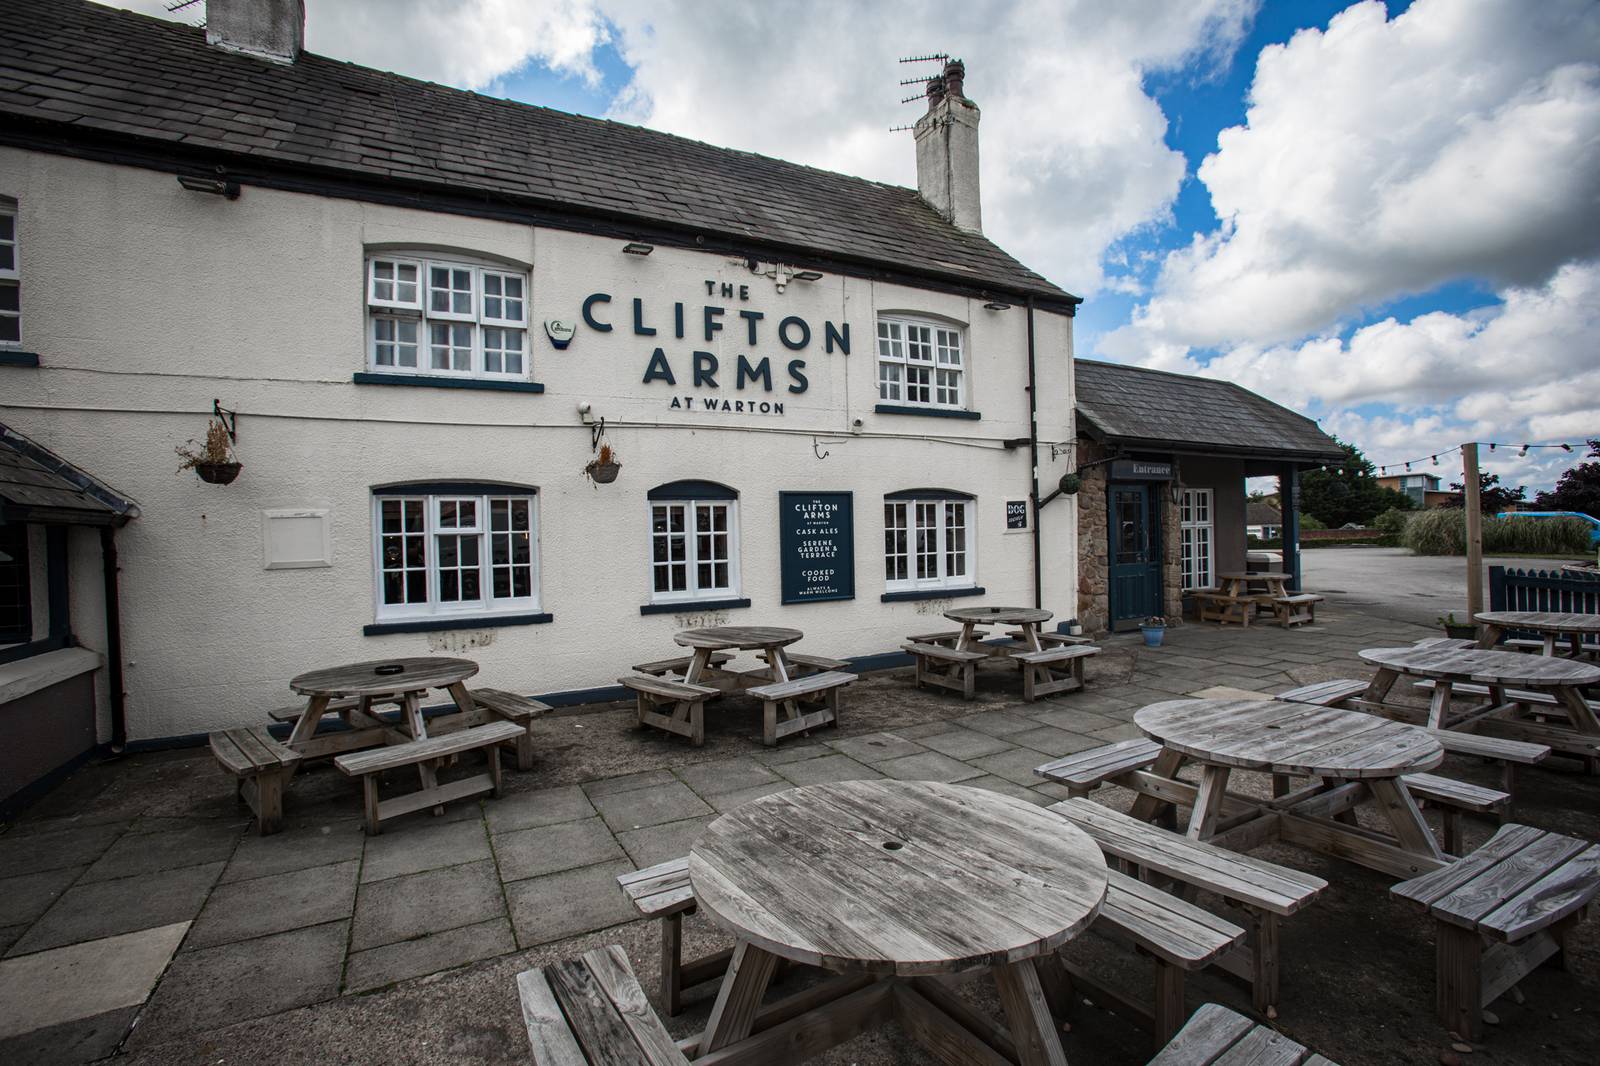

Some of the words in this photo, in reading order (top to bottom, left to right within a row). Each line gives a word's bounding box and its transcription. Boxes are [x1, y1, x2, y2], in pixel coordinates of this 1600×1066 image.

[704, 280, 750, 301] THE
[582, 293, 850, 355] CLIFTON
[642, 347, 809, 394] ARMS
[670, 397, 693, 410] AT
[704, 398, 785, 415] WARTON
[1133, 464, 1171, 475] Entrance
[1007, 504, 1025, 515] DOG
